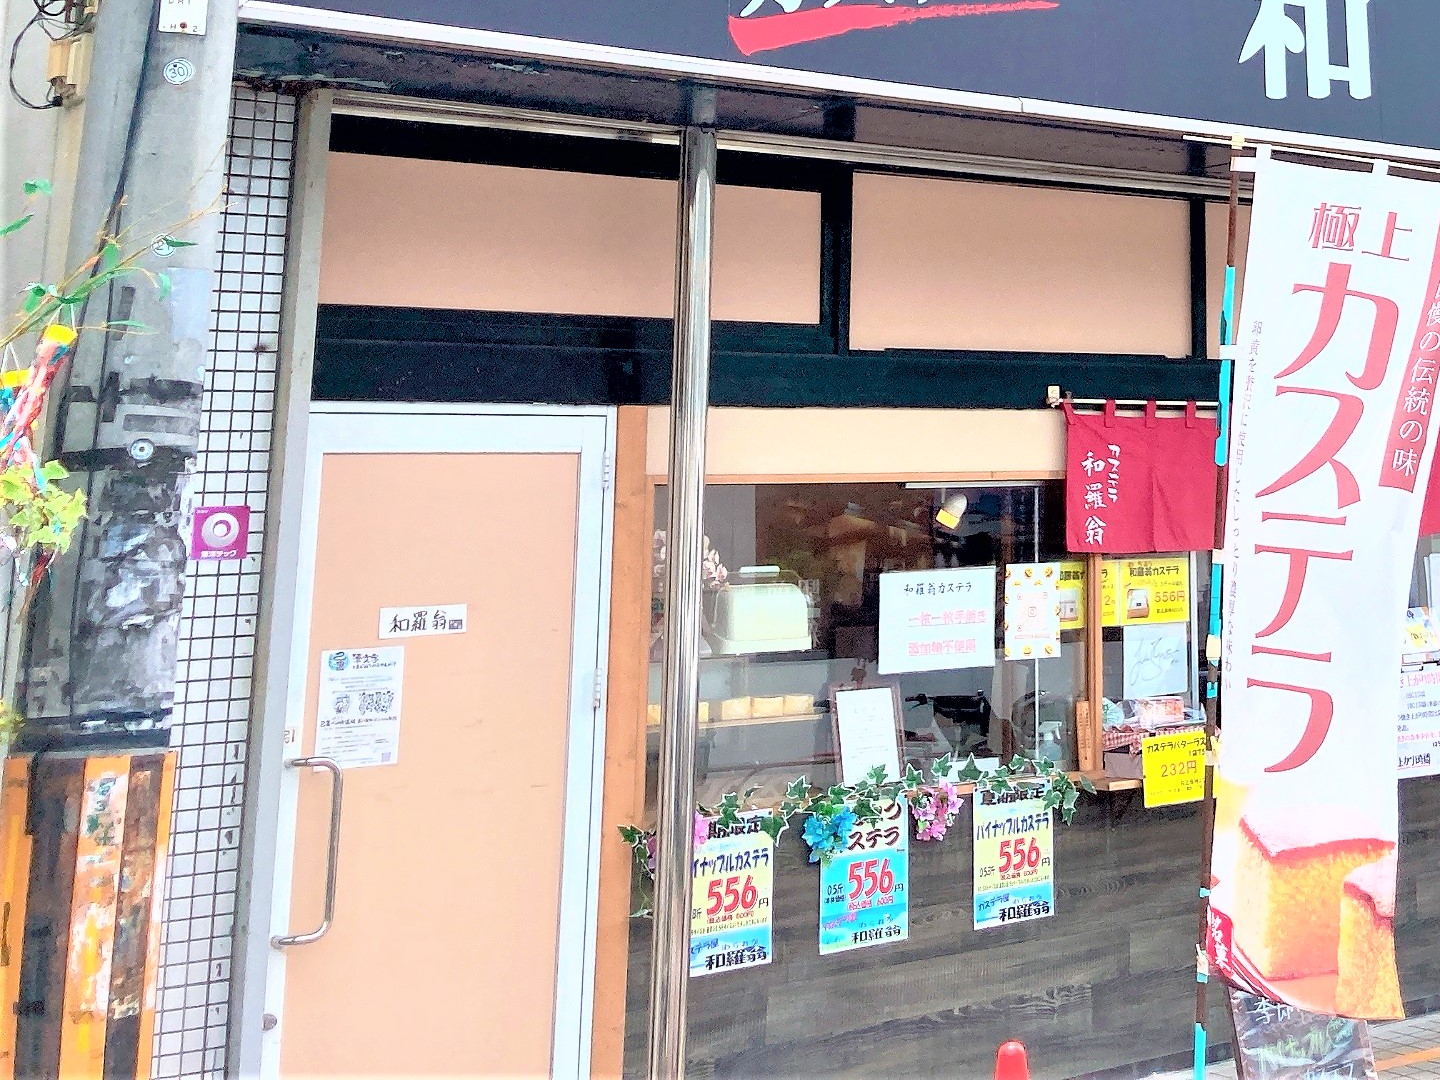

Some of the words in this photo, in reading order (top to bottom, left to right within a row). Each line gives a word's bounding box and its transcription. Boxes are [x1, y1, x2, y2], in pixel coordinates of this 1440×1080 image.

[168, 66, 185, 78] 30
[1308, 202, 1413, 262] 極上
[1107, 443, 1121, 504] カステラ
[1081, 451, 1107, 546] 和羅翁
[1246, 262, 1399, 773] カステラ
[903, 581, 973, 597] 和羅翁カステラ
[1154, 589, 1186, 604] 556円
[389, 610, 447, 633] 和羅翁
[1160, 759, 1198, 778] 232円
[840, 825, 901, 853] ステラ
[999, 836, 1051, 875] 556円
[847, 858, 904, 901] 556円
[706, 874, 769, 918] 556円
[998, 900, 1051, 923] 和羅翁
[851, 925, 902, 945] 和羅翁
[705, 945, 767, 970] 和羅翁
